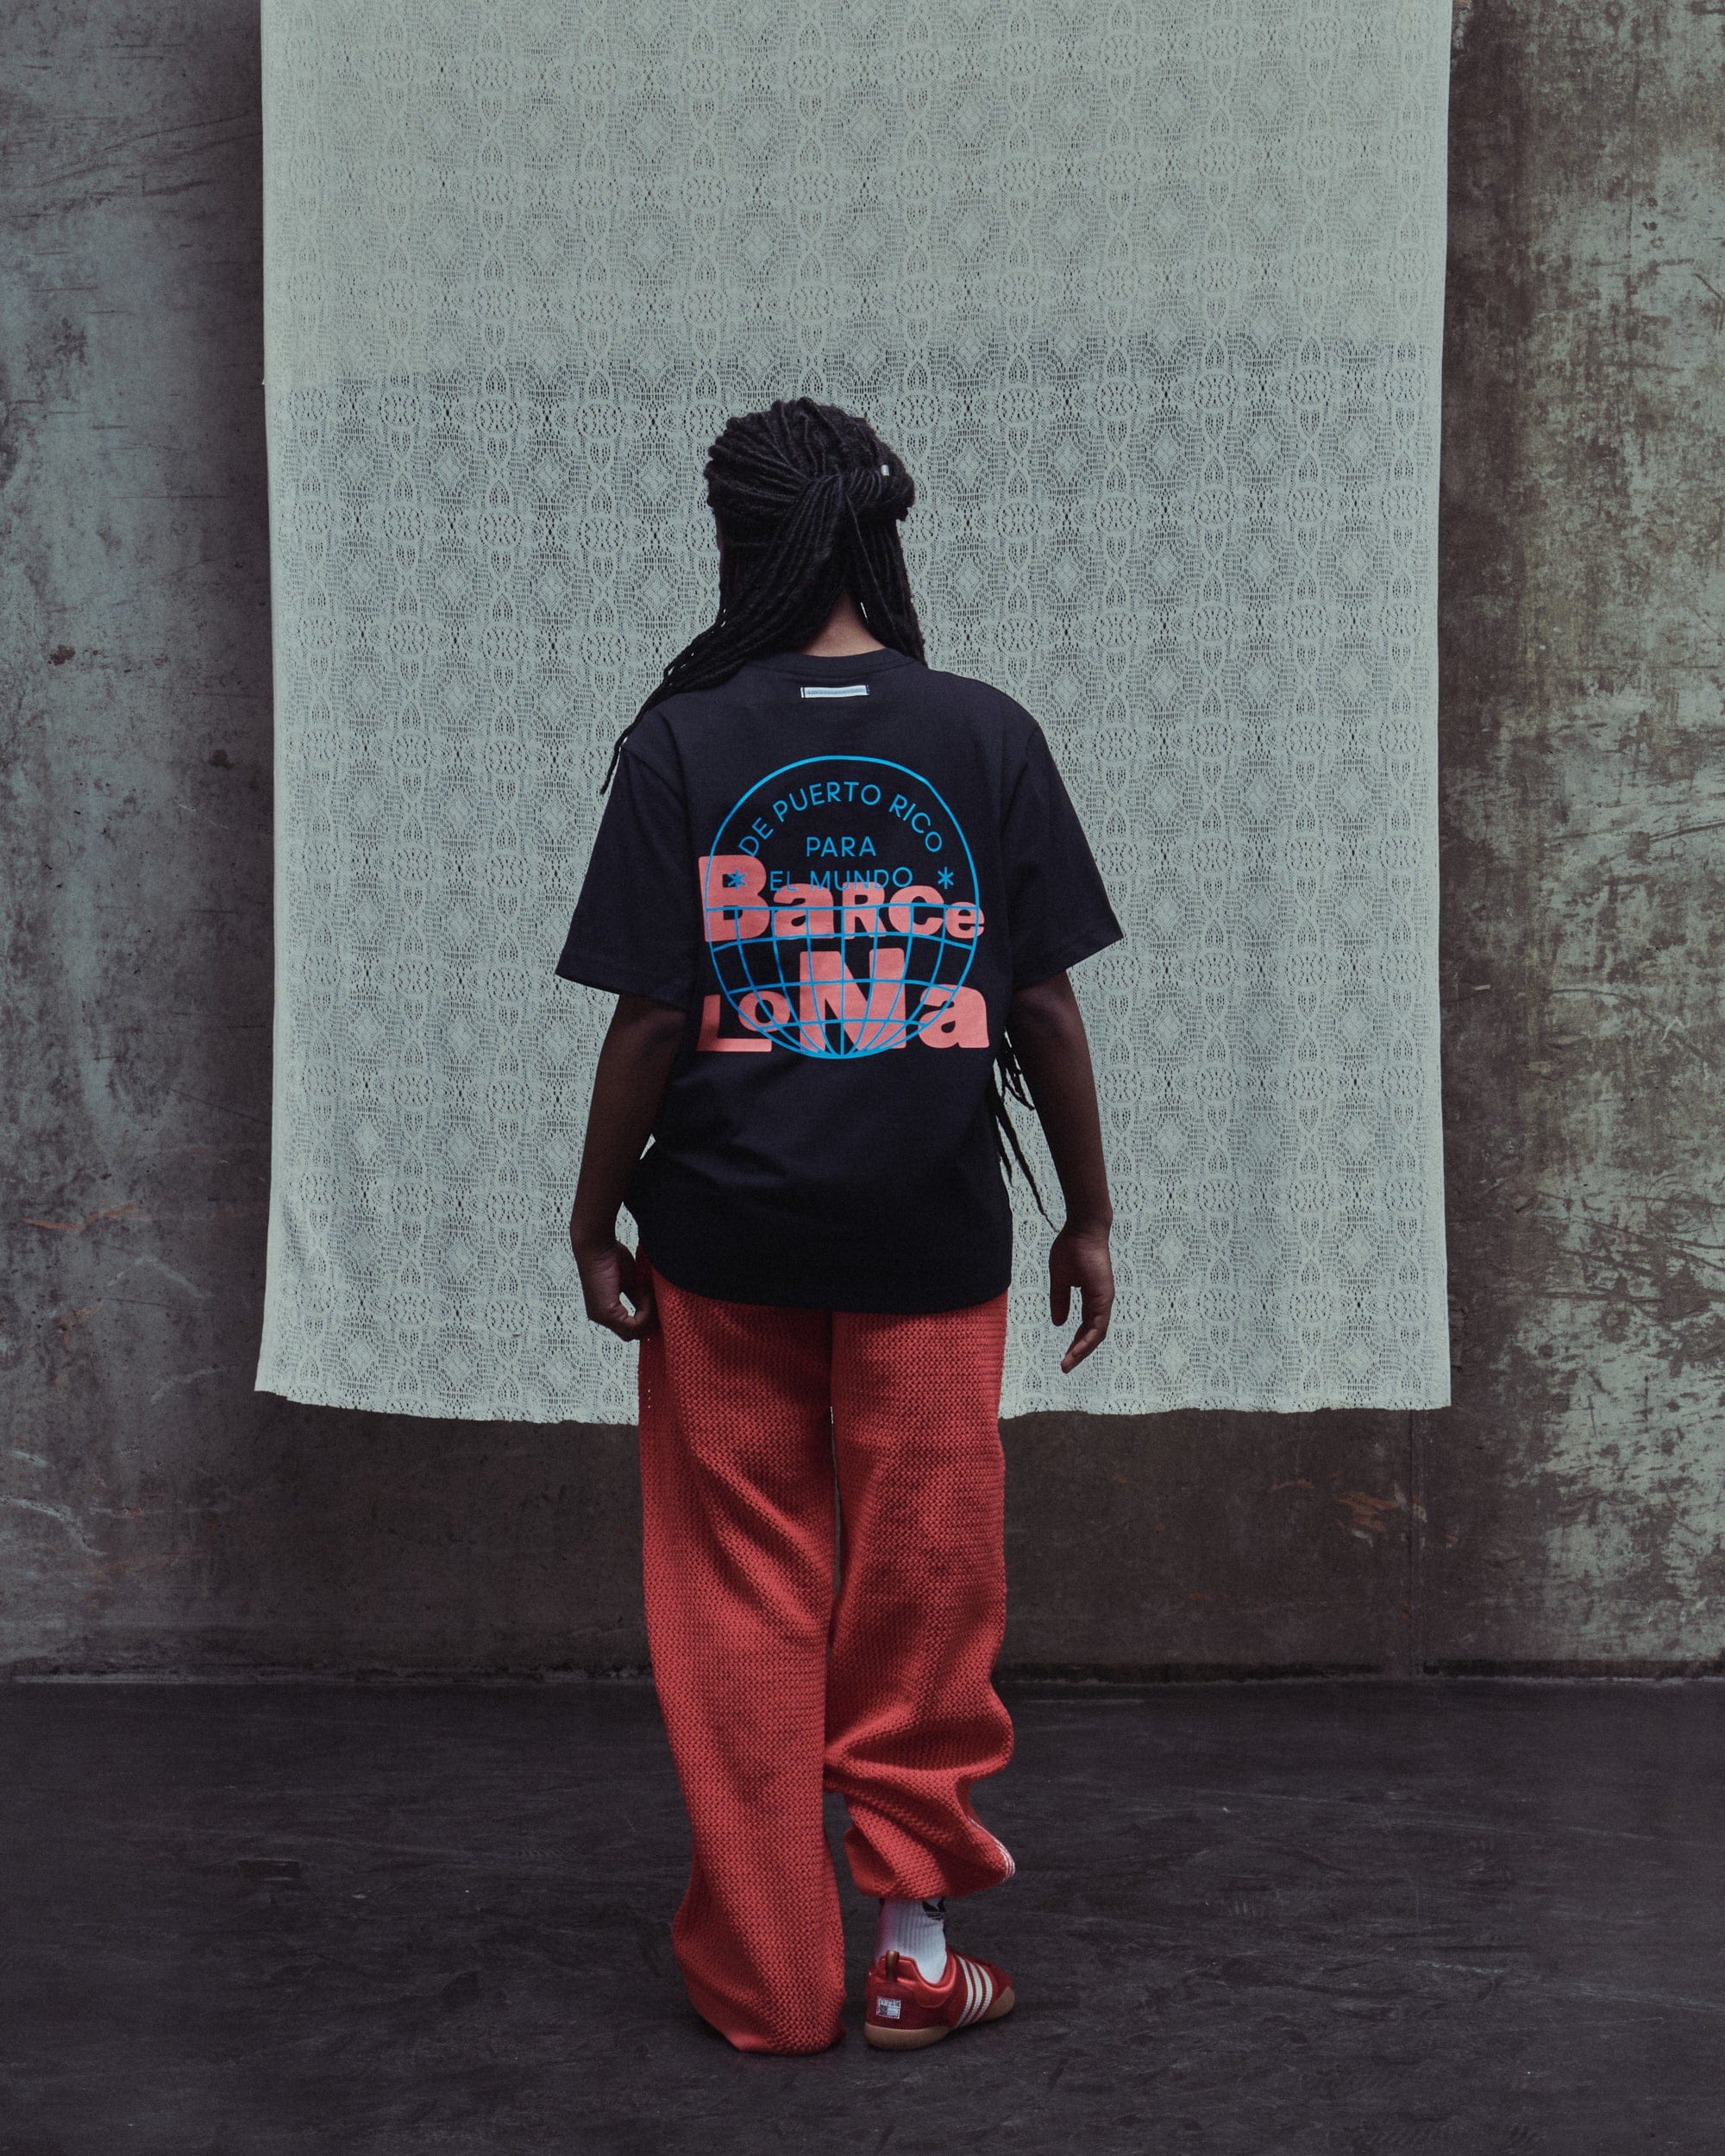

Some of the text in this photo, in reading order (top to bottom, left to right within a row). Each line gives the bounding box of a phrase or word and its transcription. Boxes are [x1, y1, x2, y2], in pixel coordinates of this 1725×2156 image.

[738, 781, 943, 856] DE PUERTO RICO
[806, 836, 876, 857] PARA
[769, 867, 913, 892] EL MUNDO
